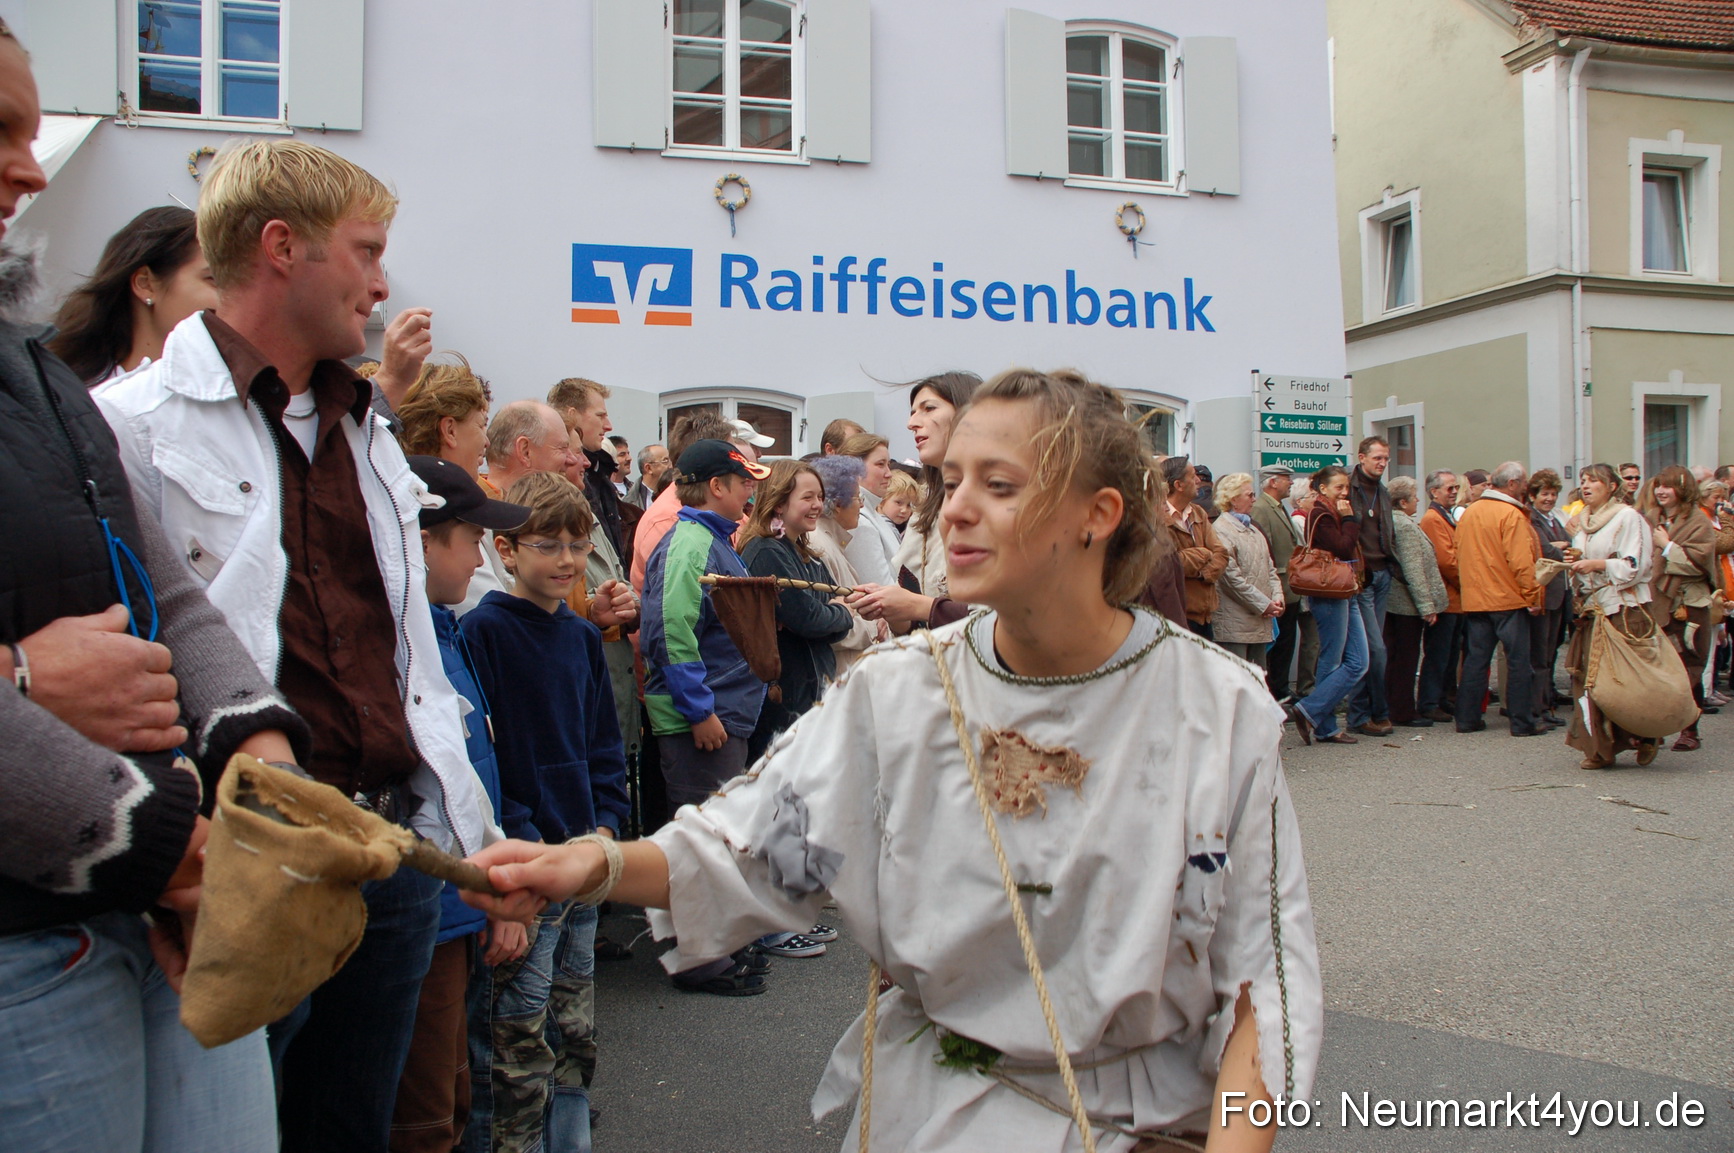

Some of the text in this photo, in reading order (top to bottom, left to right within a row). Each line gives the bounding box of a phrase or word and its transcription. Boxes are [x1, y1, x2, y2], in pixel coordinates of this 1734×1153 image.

[720, 253, 1216, 333] Raiffeisenbank
[1290, 380, 1330, 392] Friedhof
[1294, 400, 1327, 411] Bauhof
[1280, 418, 1342, 431] Reisebüro Söllner
[1265, 438, 1329, 450] Tourismusbüro
[1275, 457, 1320, 468] Apotheke
